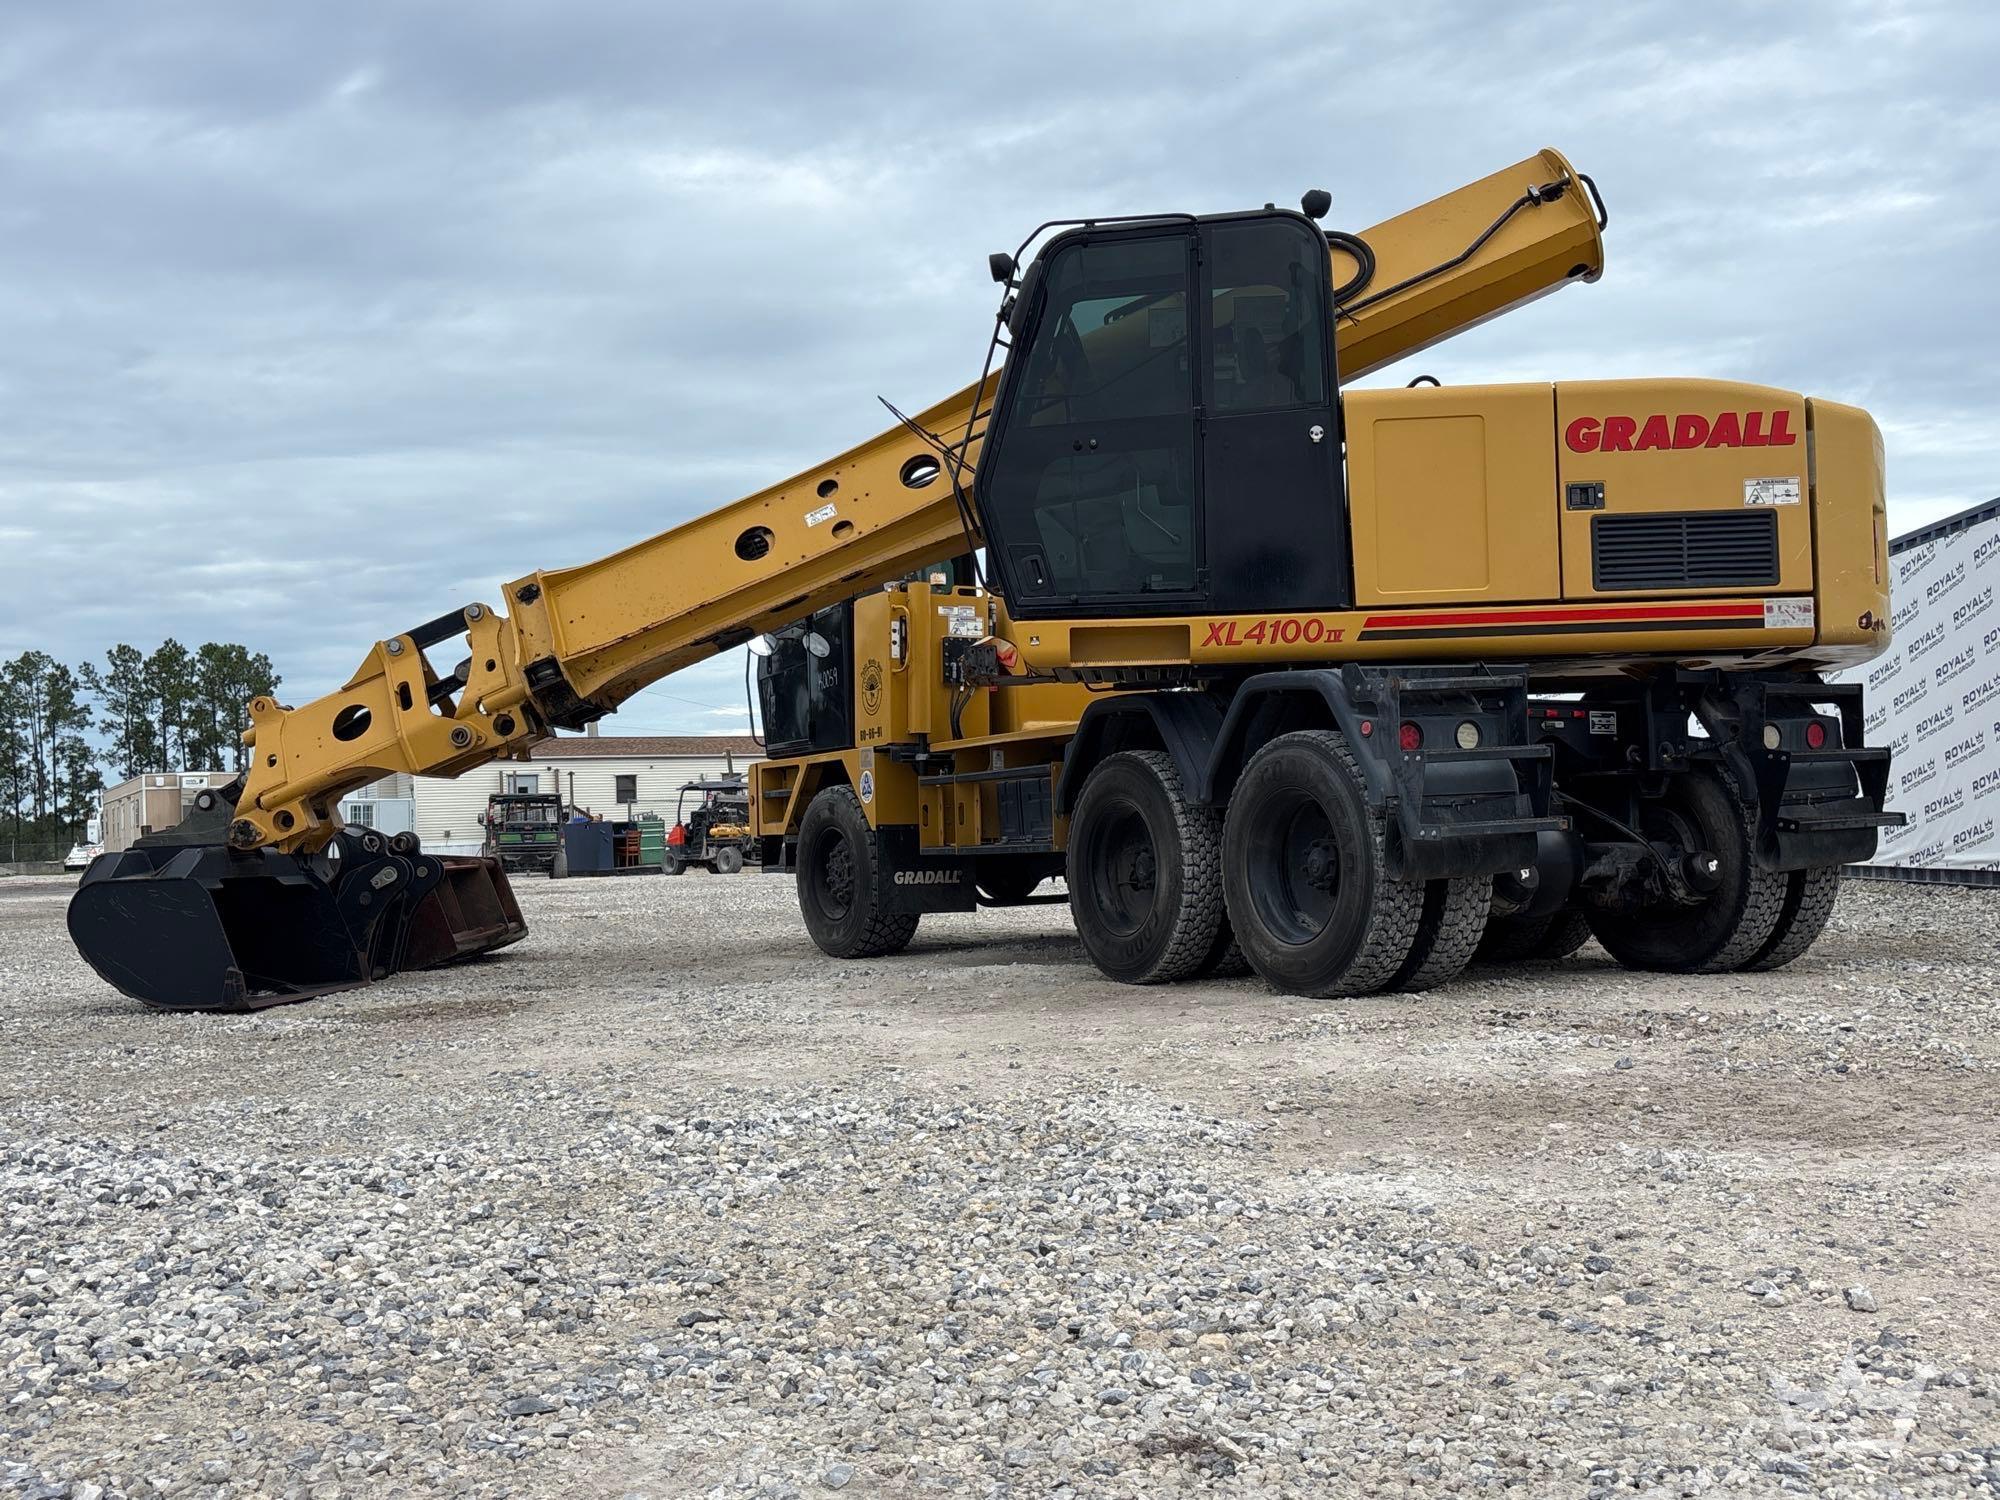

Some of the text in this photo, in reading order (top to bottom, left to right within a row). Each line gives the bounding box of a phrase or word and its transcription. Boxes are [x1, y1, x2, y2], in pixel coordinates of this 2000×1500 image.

[1565, 411, 1797, 453] GRADALL
[1973, 534, 2000, 562] ROYA
[1900, 549, 1927, 578] ROYAL
[1926, 570, 1956, 599] ROYAL
[1892, 605, 1912, 627] OYAL
[1953, 594, 1984, 623] ROYAL
[1201, 618, 1325, 647] XL4100
[1908, 629, 1936, 656] ROYAL
[1869, 660, 1894, 685] ROYAL
[1935, 652, 1966, 680] ROYAL
[1893, 684, 1919, 708] ROYAL
[1962, 679, 1994, 707] ROYAL
[1965, 697, 1986, 715] AUCTION
[1865, 712, 1879, 727] YAL
[1916, 710, 1945, 735] ROYAL
[1918, 727, 1937, 743] AUCTION
[1944, 737, 1976, 762] ROYAL
[1947, 744, 1985, 769] AUCTION GROUP
[1901, 764, 1928, 787] ROYAL
[1972, 768, 2000, 793] ROYA
[1924, 793, 1955, 816] ROYAL
[1974, 785, 1996, 800] AUCTION
[1926, 810, 1946, 824] AUCTION
[1953, 824, 1985, 846] ROYAL
[1955, 831, 1994, 854] AUCTION GROUP
[1909, 846, 1936, 867] ROYAL
